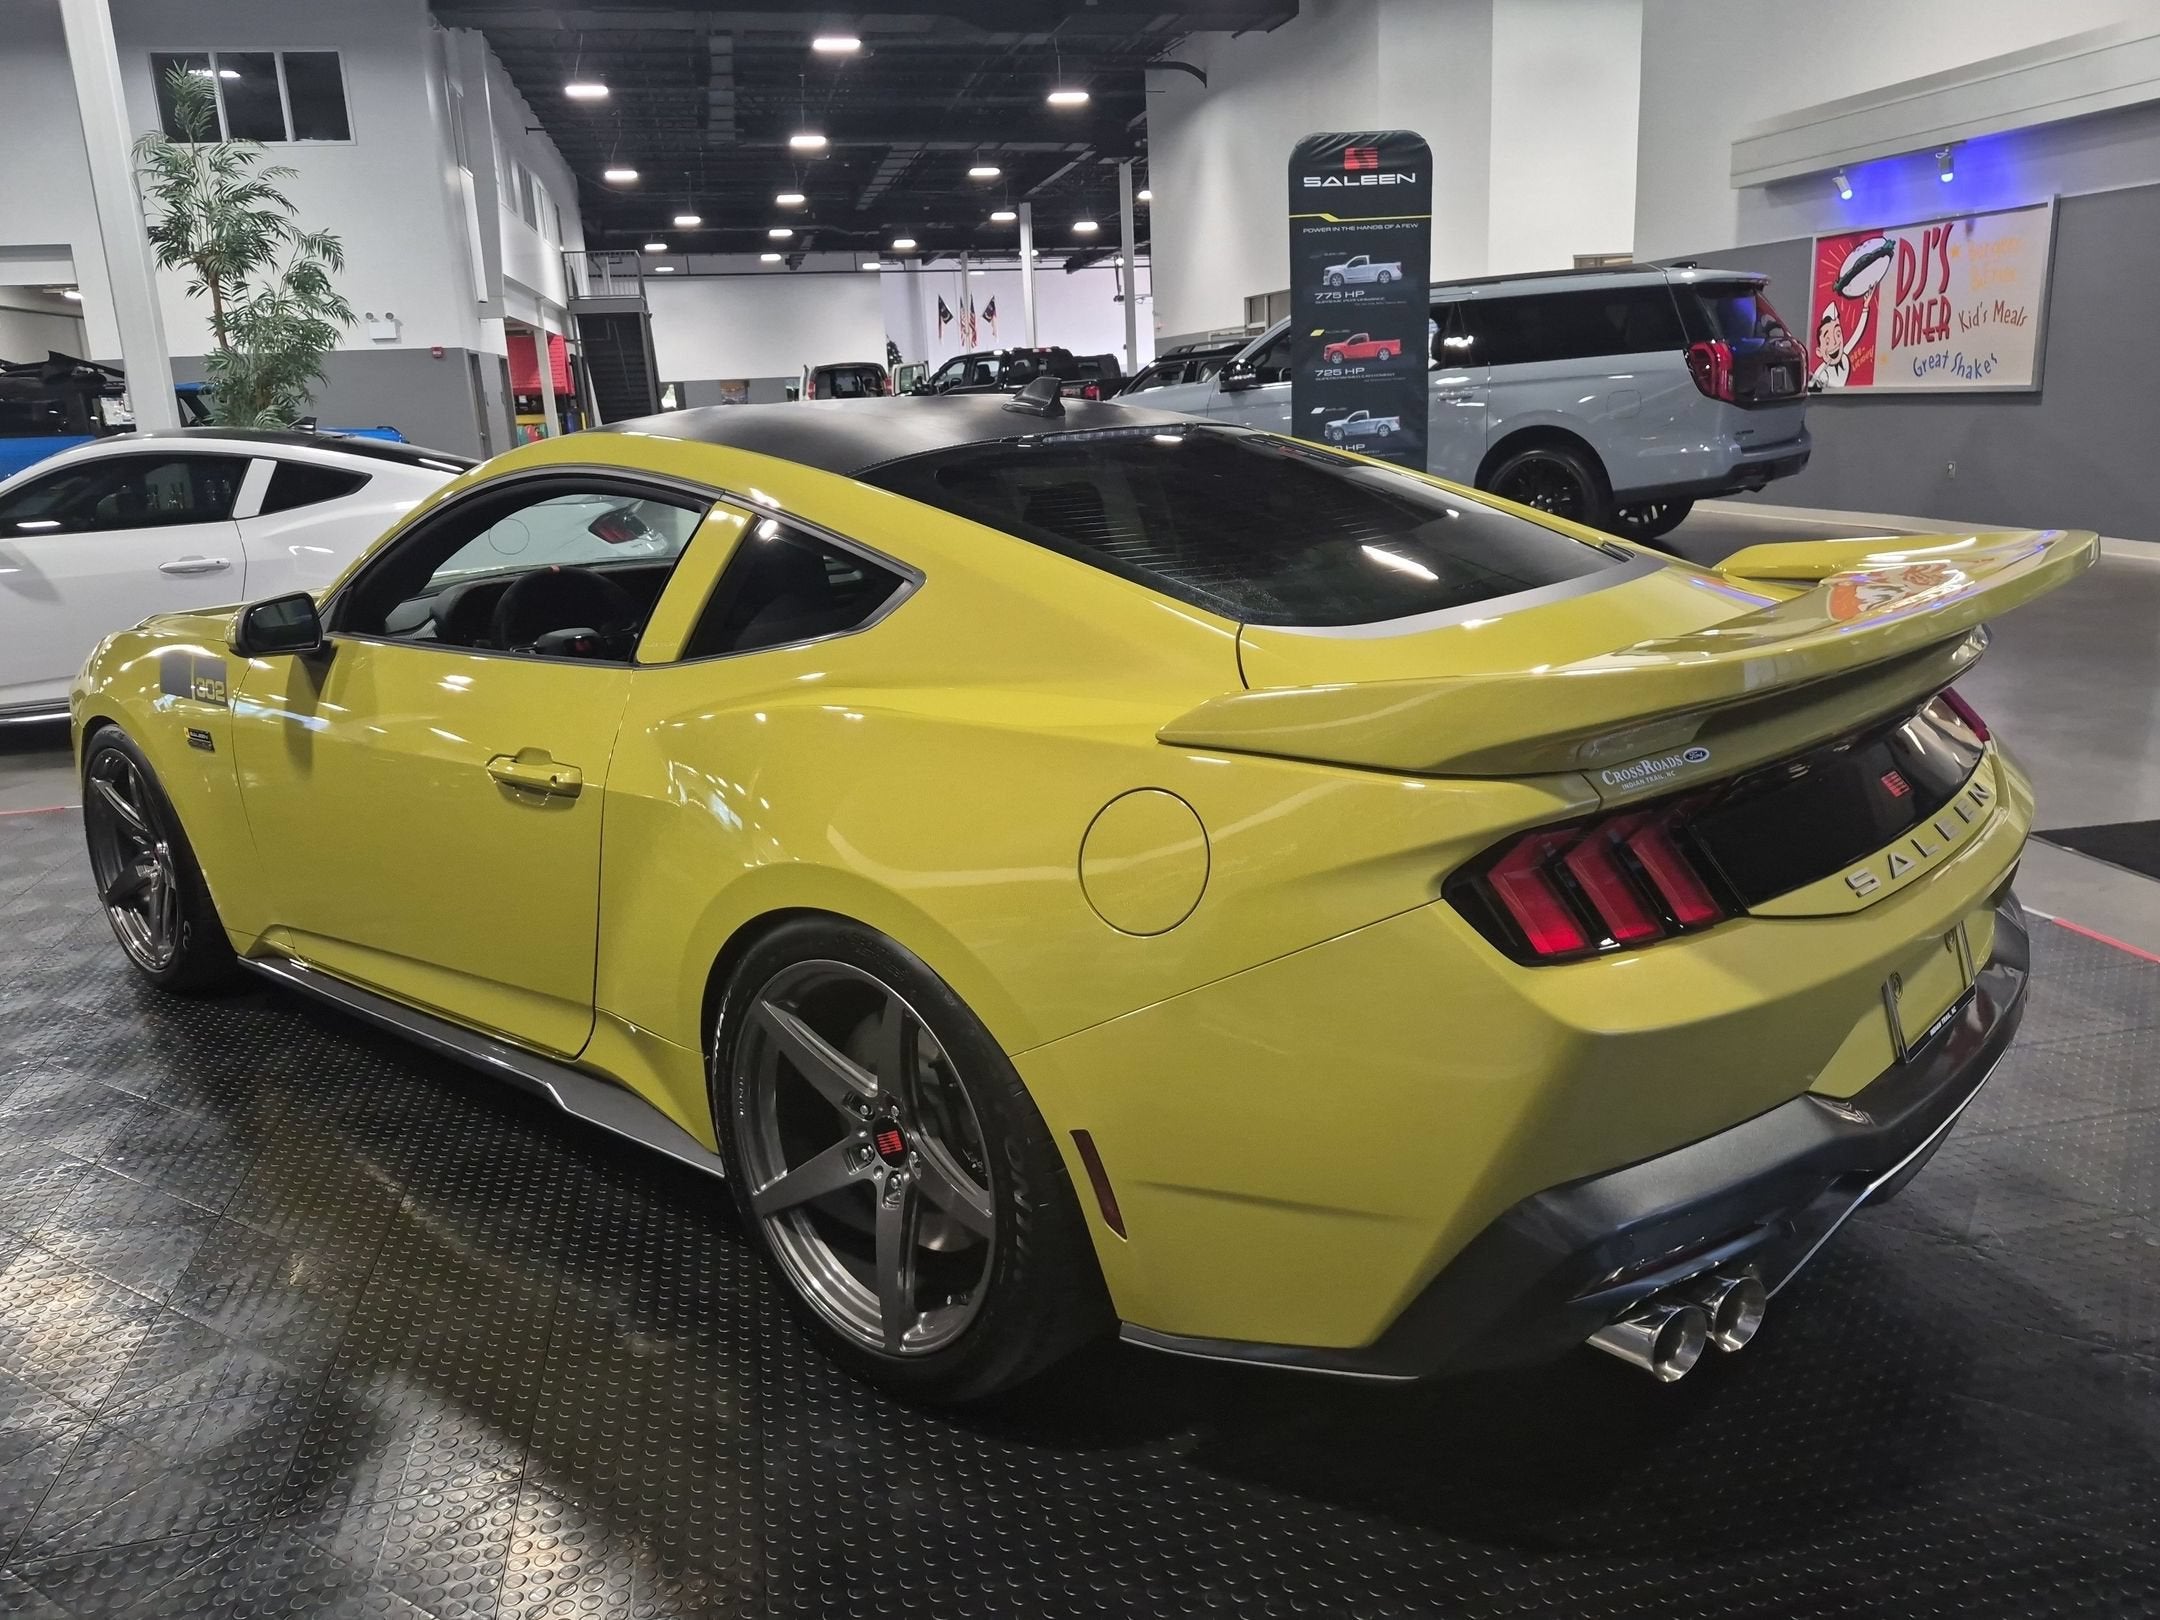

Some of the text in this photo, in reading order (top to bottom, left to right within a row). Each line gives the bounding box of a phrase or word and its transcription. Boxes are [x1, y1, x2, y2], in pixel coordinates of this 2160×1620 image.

[1303, 172, 1416, 188] SALEEN
[1896, 222, 1954, 307] DJ'S
[1314, 291, 1342, 300] 775
[1344, 290, 1365, 298] HP
[1891, 295, 1952, 350] DINER
[1958, 300, 2028, 333] Kid's Meals
[1314, 368, 1342, 377] 725
[1344, 367, 1365, 375] HP
[1912, 350, 1998, 380] Great Shakes
[1345, 443, 1366, 451] HP
[1622, 779, 1645, 790] INDIAN
[1845, 782, 1990, 898] SALEEN
